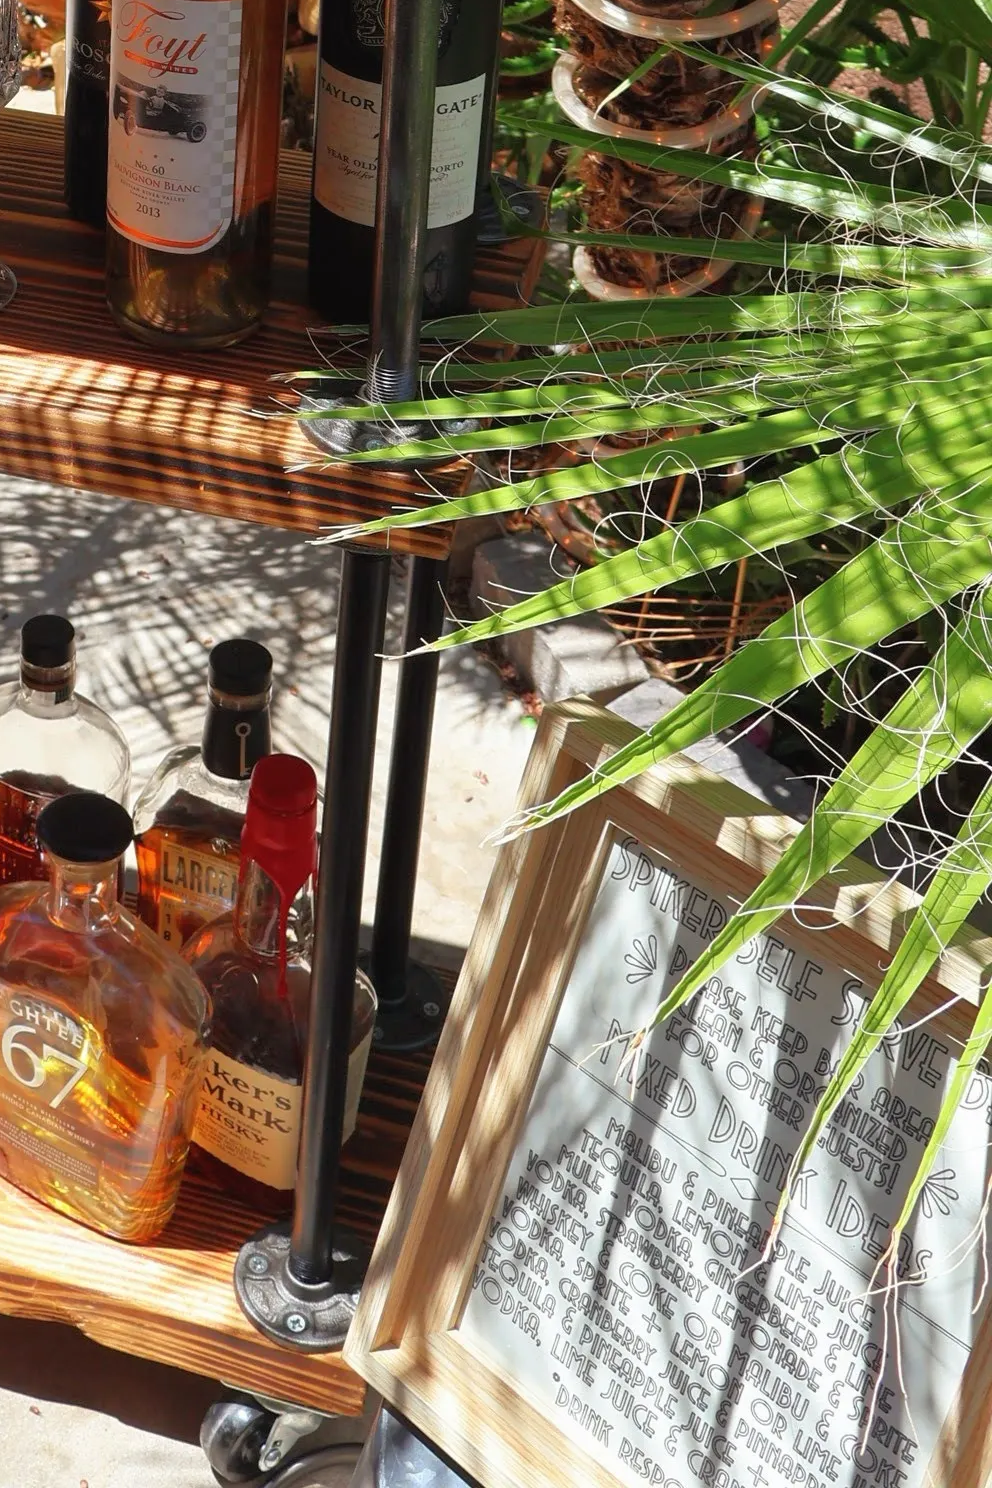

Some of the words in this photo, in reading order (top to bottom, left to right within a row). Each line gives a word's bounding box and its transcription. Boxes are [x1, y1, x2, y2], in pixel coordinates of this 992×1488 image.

[72, 36, 110, 63] ROS
[321, 77, 378, 114] TAYLOR
[436, 94, 479, 115] GATE
[135, 160, 149, 172] No.
[151, 165, 165, 175] 60
[135, 202, 161, 218] 2013
[162, 194, 186, 203] VALLEY
[164, 181, 200, 193] BLANC
[326, 146, 349, 163] YEAR
[353, 159, 377, 171] OLD
[1, 1024, 88, 1109] 67
[212, 1060, 292, 1111] ker's
[665, 1014, 718, 1072] FOR
[726, 1061, 804, 1132] OTHER
[669, 944, 746, 1021] PASE
[750, 1005, 808, 1057] KEEP
[870, 1087, 936, 1147] AREA
[831, 979, 949, 1089] SRVE
[201, 1103, 268, 1146] HISKY
[202, 1076, 292, 1134] Mark
[708, 1094, 818, 1210] DRINK
[527, 1149, 588, 1219] VODKA,
[596, 1207, 709, 1303] STRAWBERRY
[712, 1294, 822, 1393] LEMONADE
[557, 1144, 605, 1195] MULE
[622, 1194, 693, 1268] VODKA,
[704, 1258, 817, 1357] GINGERBEER
[581, 1126, 663, 1214] TEQUILA,
[672, 1200, 749, 1274] LEMON
[774, 1276, 824, 1328] LIME
[605, 1117, 677, 1184] MALIBU
[813, 1270, 876, 1332] JUICE
[469, 1264, 541, 1347] VODKA,
[550, 1333, 597, 1387] LIME
[600, 1379, 658, 1439] JUICE
[477, 1238, 556, 1319] TEQUILA
[579, 1324, 678, 1420] PINEAPPLE
[679, 1406, 737, 1468] JUICE
[485, 1214, 549, 1286] VODKA,
[559, 1278, 657, 1366] CRANBERRY
[658, 1360, 711, 1412] JUICE
[502, 1195, 565, 1268] VODKA,
[573, 1256, 632, 1316] SPRITE
[669, 1332, 744, 1405] LEMON
[751, 1398, 791, 1440] OR
[792, 1428, 842, 1482] LIME
[514, 1176, 594, 1251] WHISKEY
[619, 1262, 679, 1321] COKE
[683, 1312, 721, 1356] OR
[727, 1344, 810, 1421] MALIBU
[840, 1434, 908, 1488] COKE
